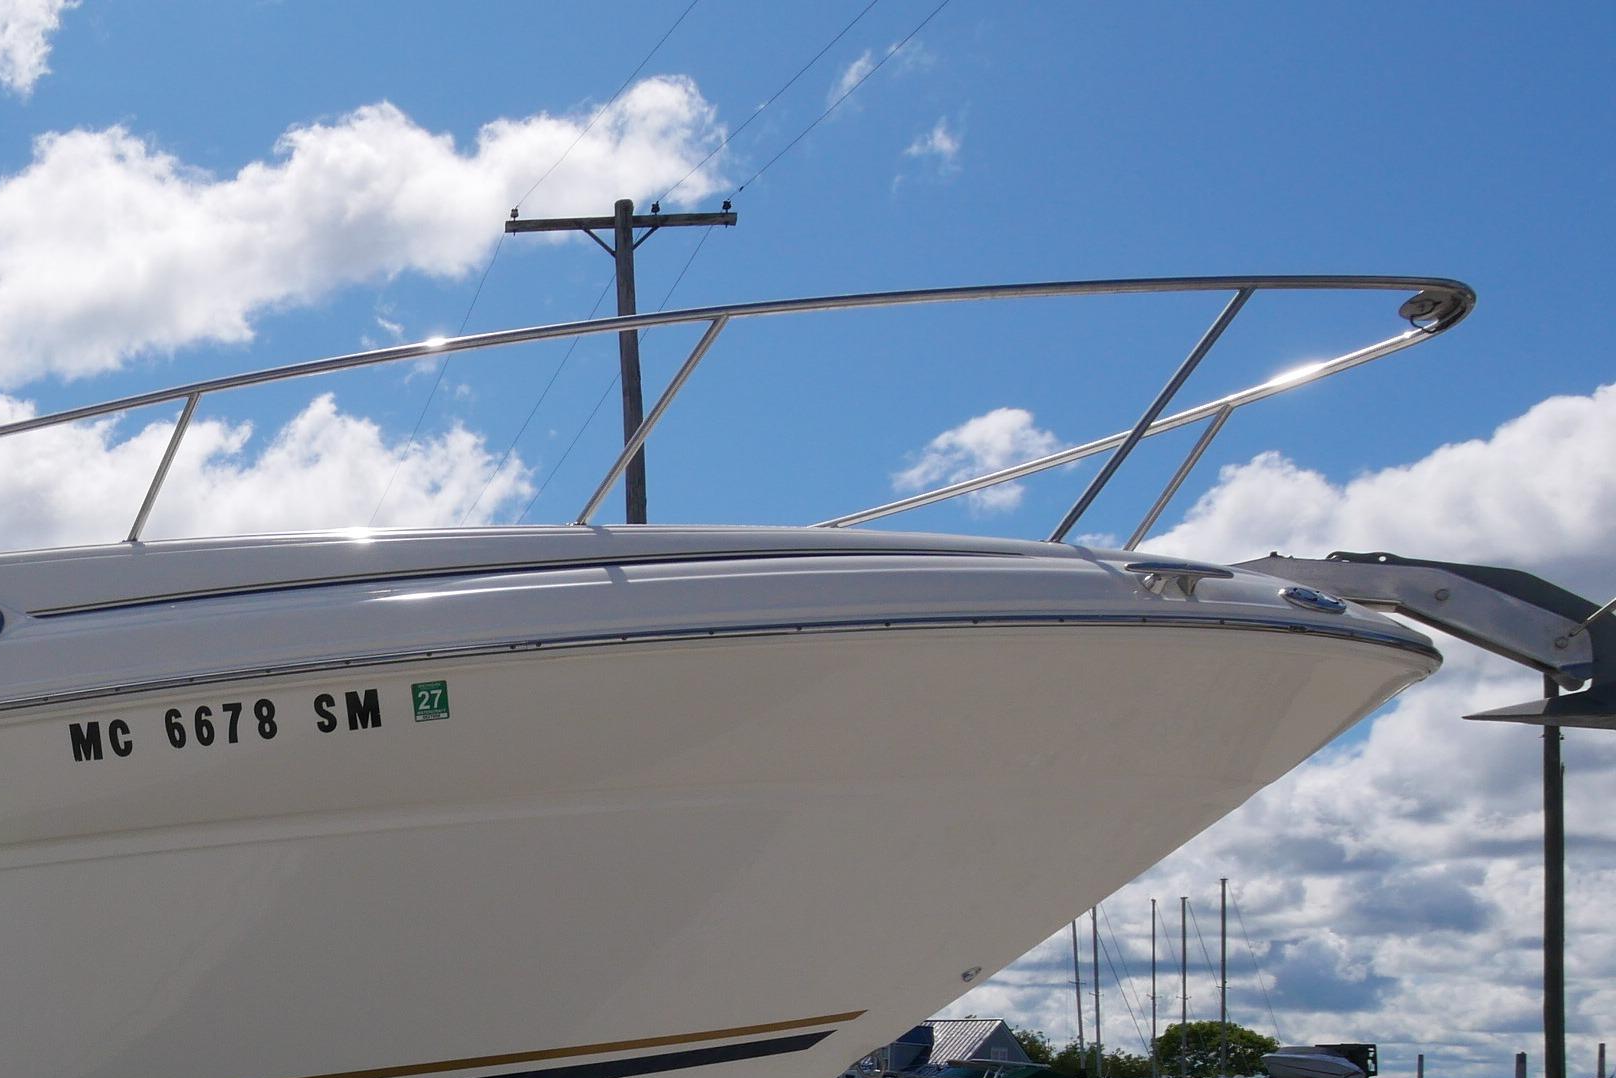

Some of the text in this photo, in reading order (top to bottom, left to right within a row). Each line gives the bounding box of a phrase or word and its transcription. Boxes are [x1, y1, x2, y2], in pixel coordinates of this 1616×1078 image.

[418, 689, 442, 710] 27
[69, 688, 382, 762] MC 6678 SM
